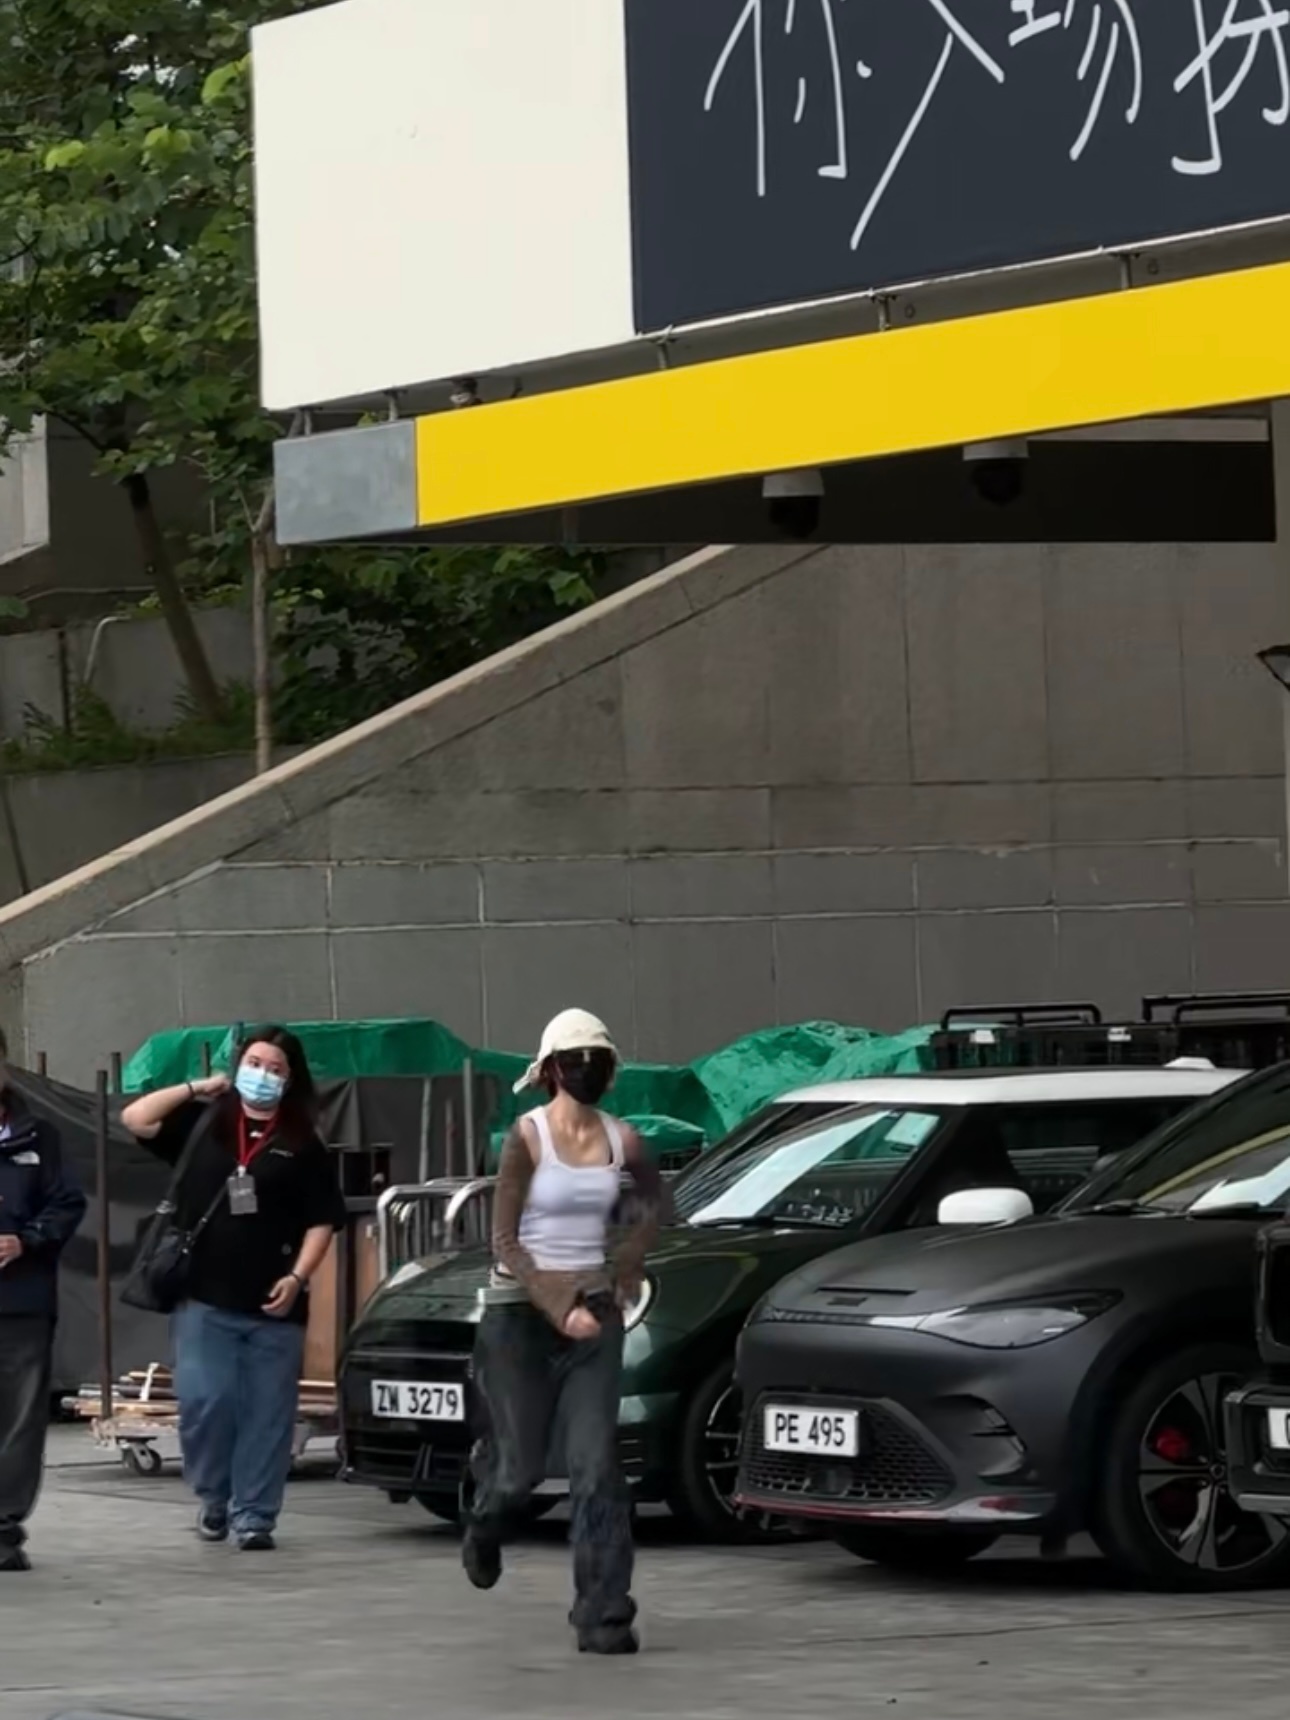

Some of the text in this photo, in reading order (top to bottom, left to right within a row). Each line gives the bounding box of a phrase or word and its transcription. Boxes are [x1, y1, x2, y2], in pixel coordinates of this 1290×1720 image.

[408, 1387, 459, 1416] 3279
[775, 1413, 846, 1447] PE 495
